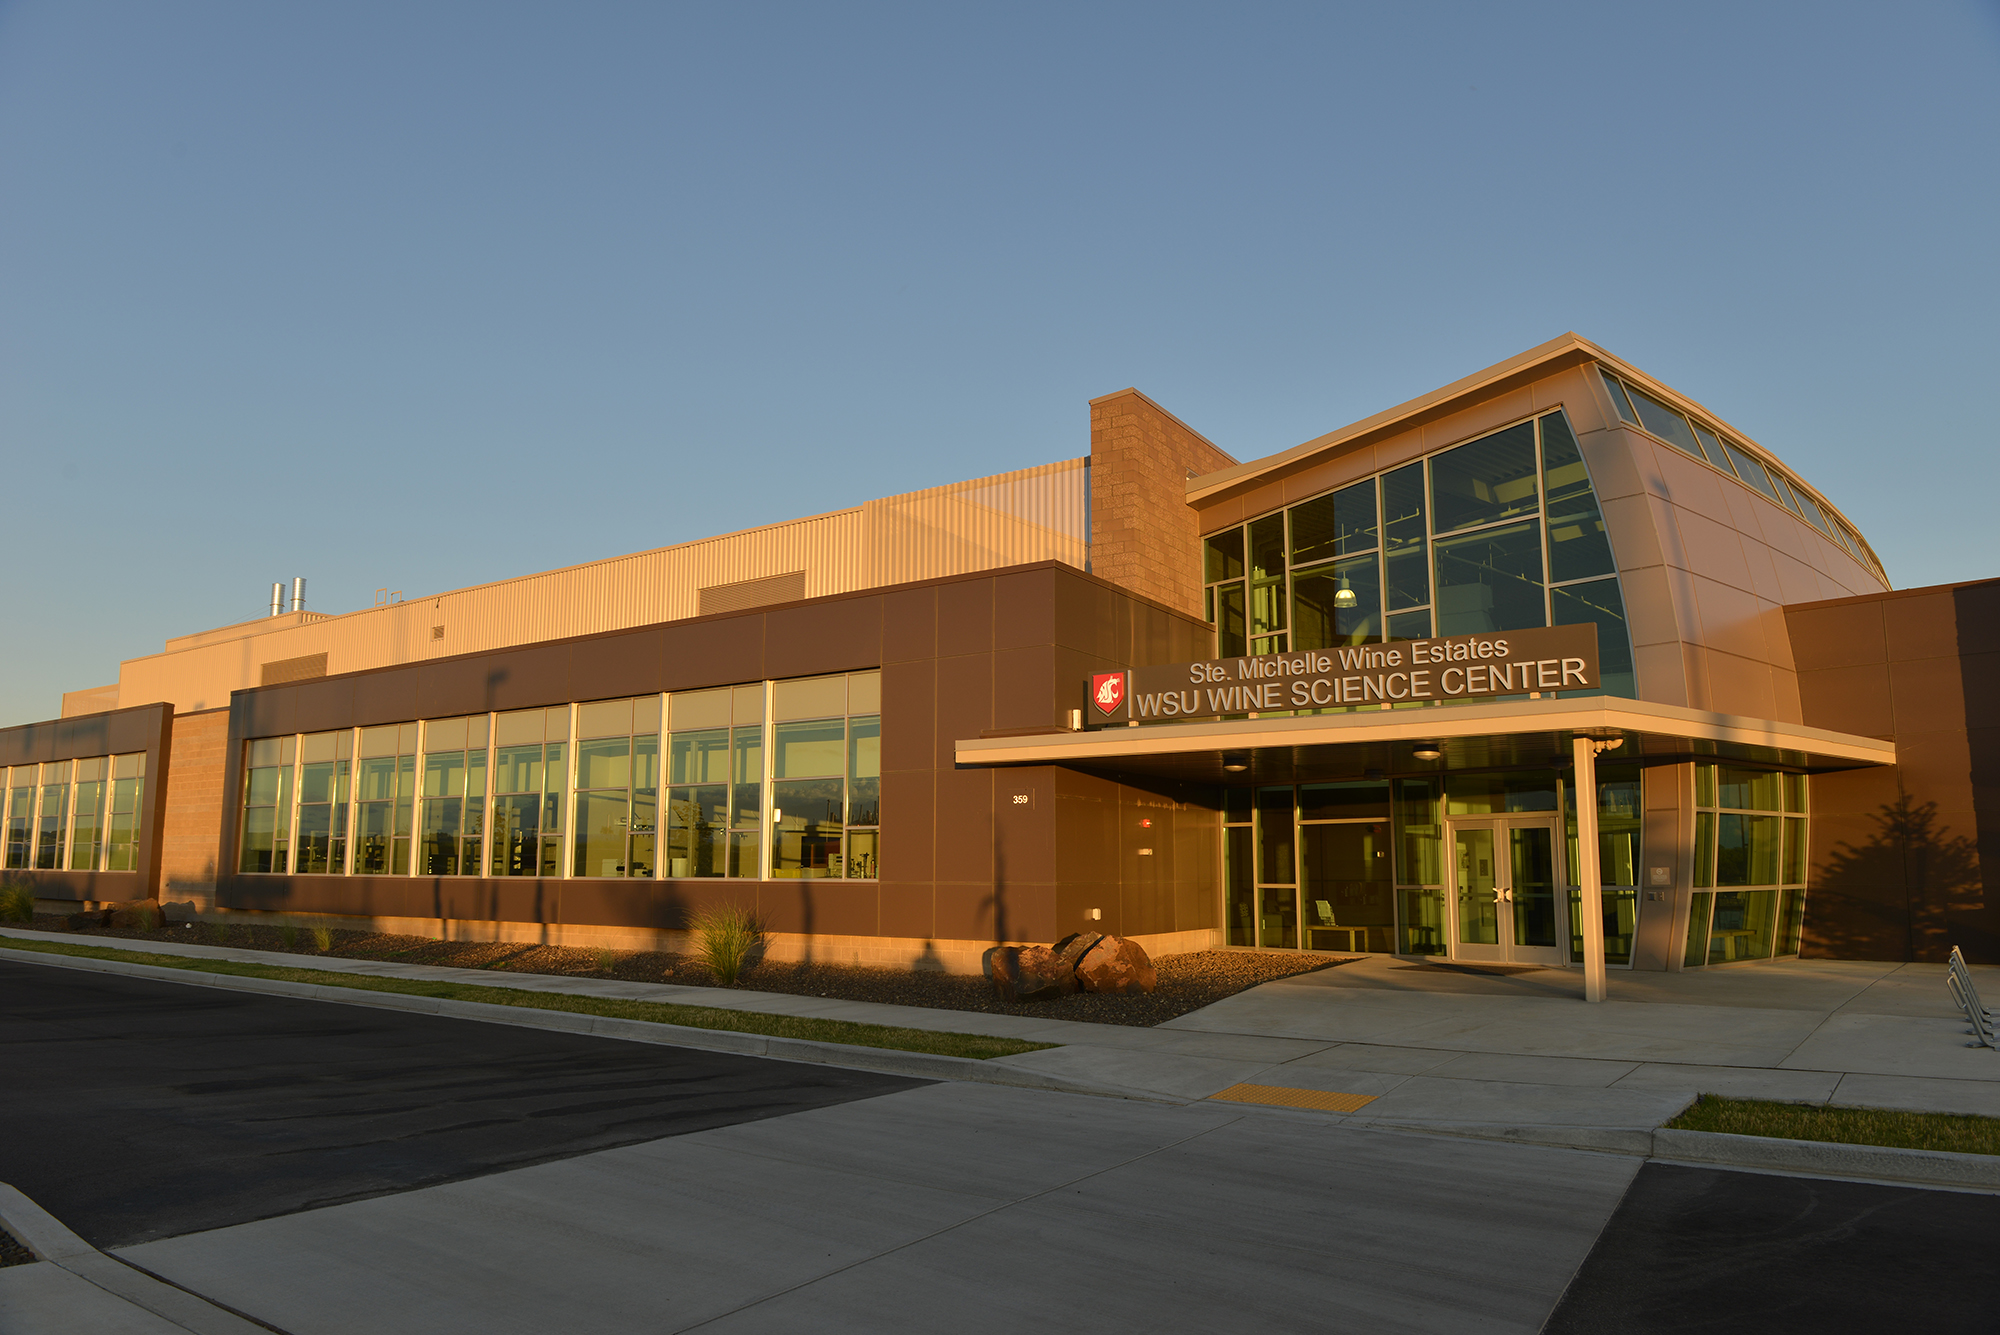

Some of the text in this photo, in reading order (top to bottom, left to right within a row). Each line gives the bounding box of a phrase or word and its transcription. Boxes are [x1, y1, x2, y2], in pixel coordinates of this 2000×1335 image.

[1189, 636, 1509, 684] Ste. Michelle Wine Estates
[1136, 657, 1588, 717] WSU WINE SCIENCE CENTER
[1012, 794, 1029, 804] 359
